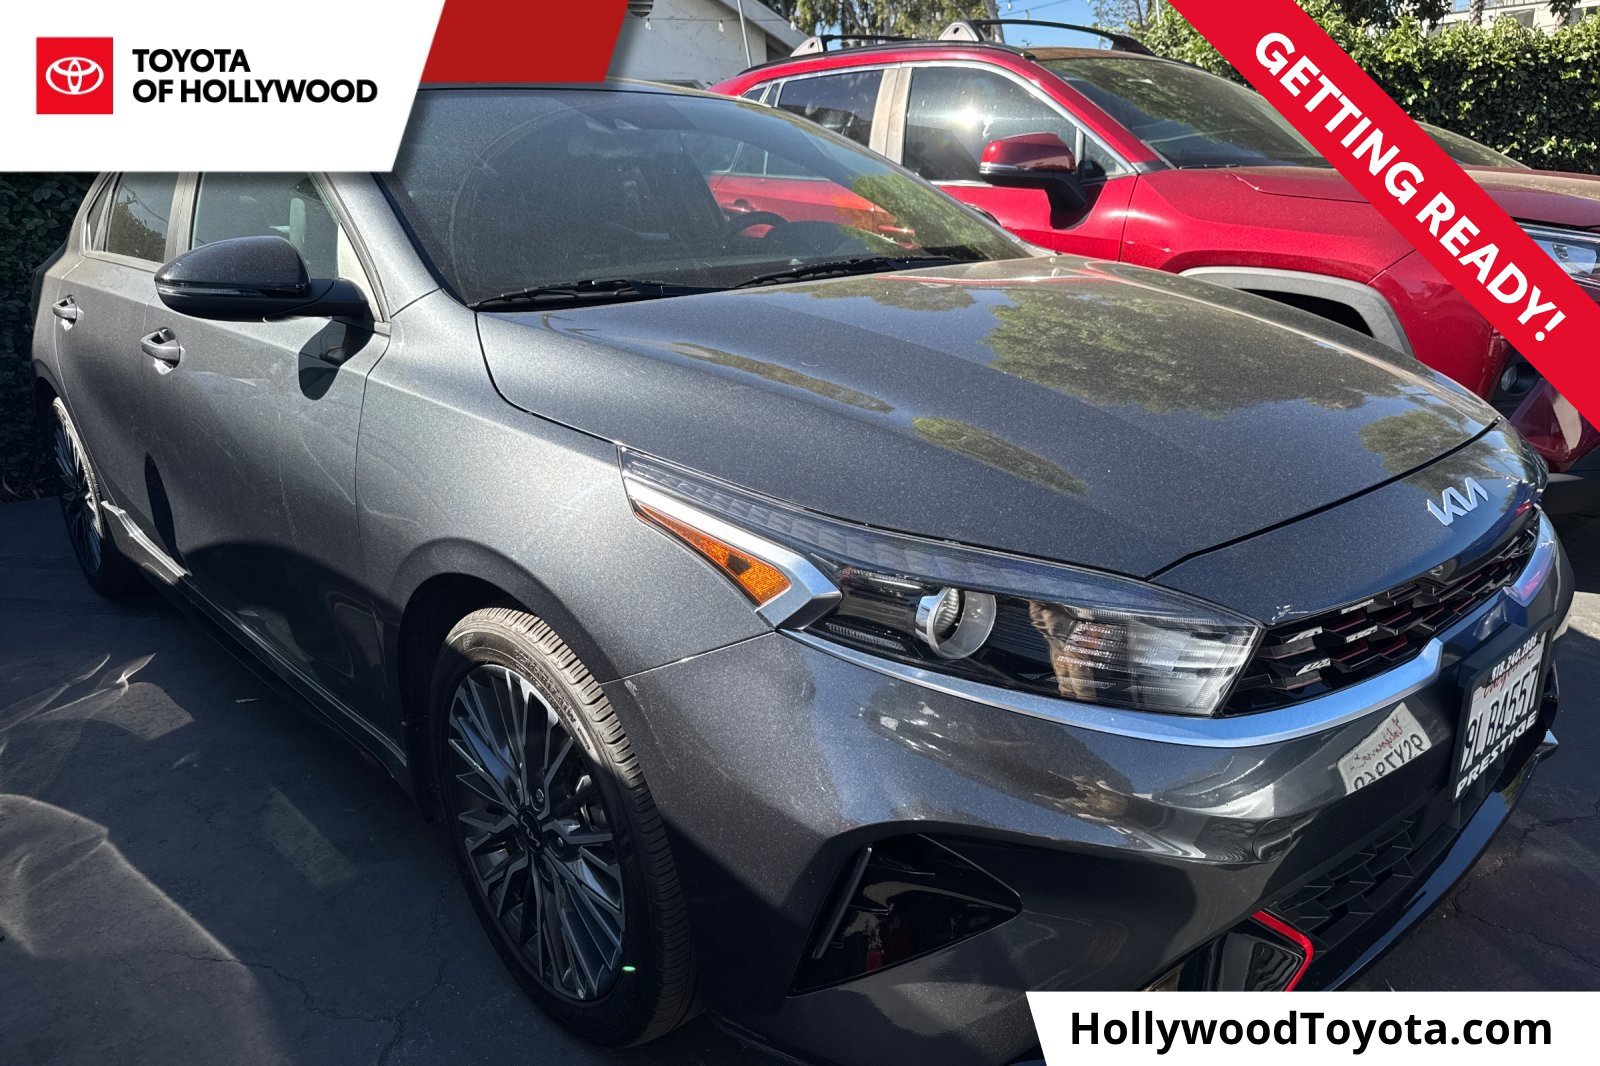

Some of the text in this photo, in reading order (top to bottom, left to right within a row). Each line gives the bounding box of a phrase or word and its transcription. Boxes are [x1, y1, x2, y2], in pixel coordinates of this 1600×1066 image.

[1427, 477, 1489, 526] KIA
[1455, 710, 1538, 799] PRESTIGE
[1459, 662, 1542, 773] 9LBA557
